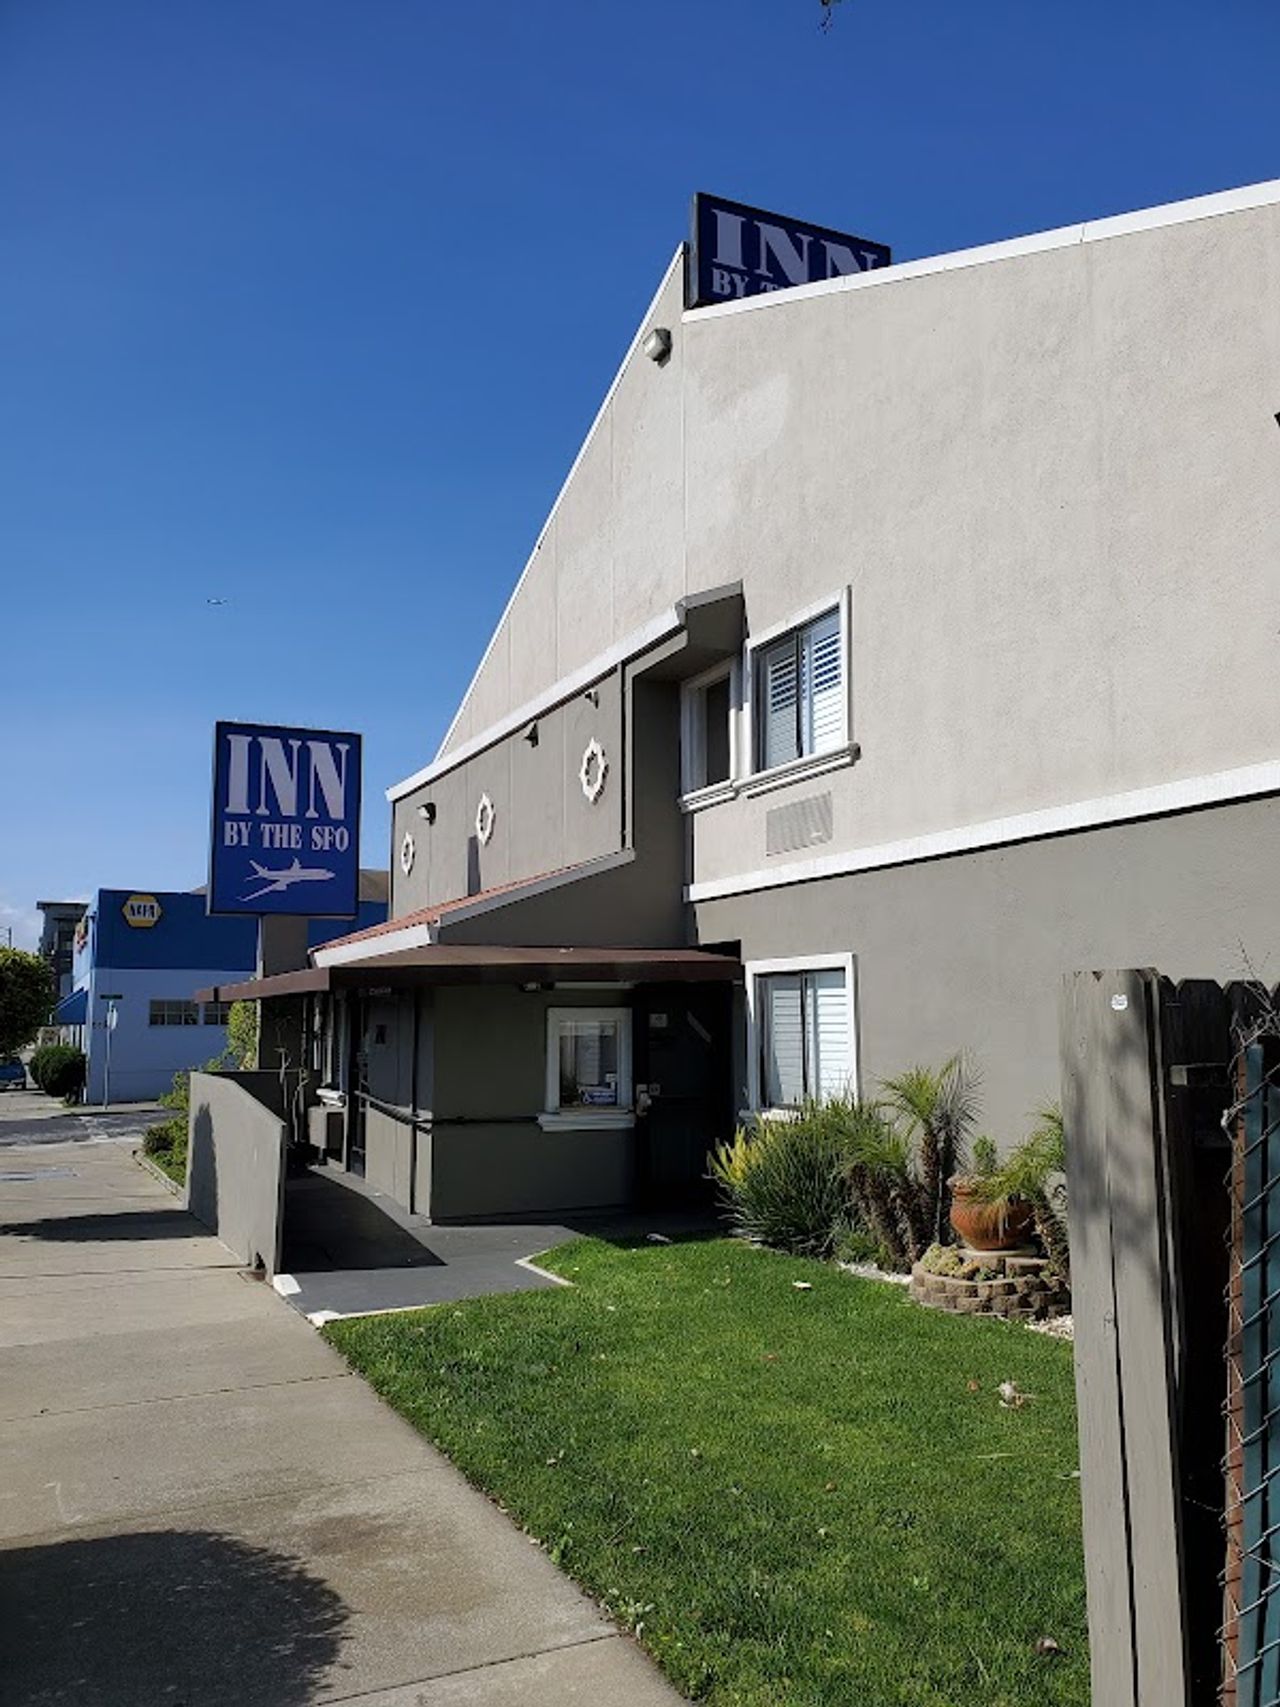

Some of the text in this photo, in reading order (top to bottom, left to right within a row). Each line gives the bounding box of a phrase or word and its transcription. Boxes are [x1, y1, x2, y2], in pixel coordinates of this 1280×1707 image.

[711, 208, 878, 285] INN
[712, 267, 750, 299] BY
[224, 734, 350, 820] INN
[224, 821, 349, 852] BY THE SFO
